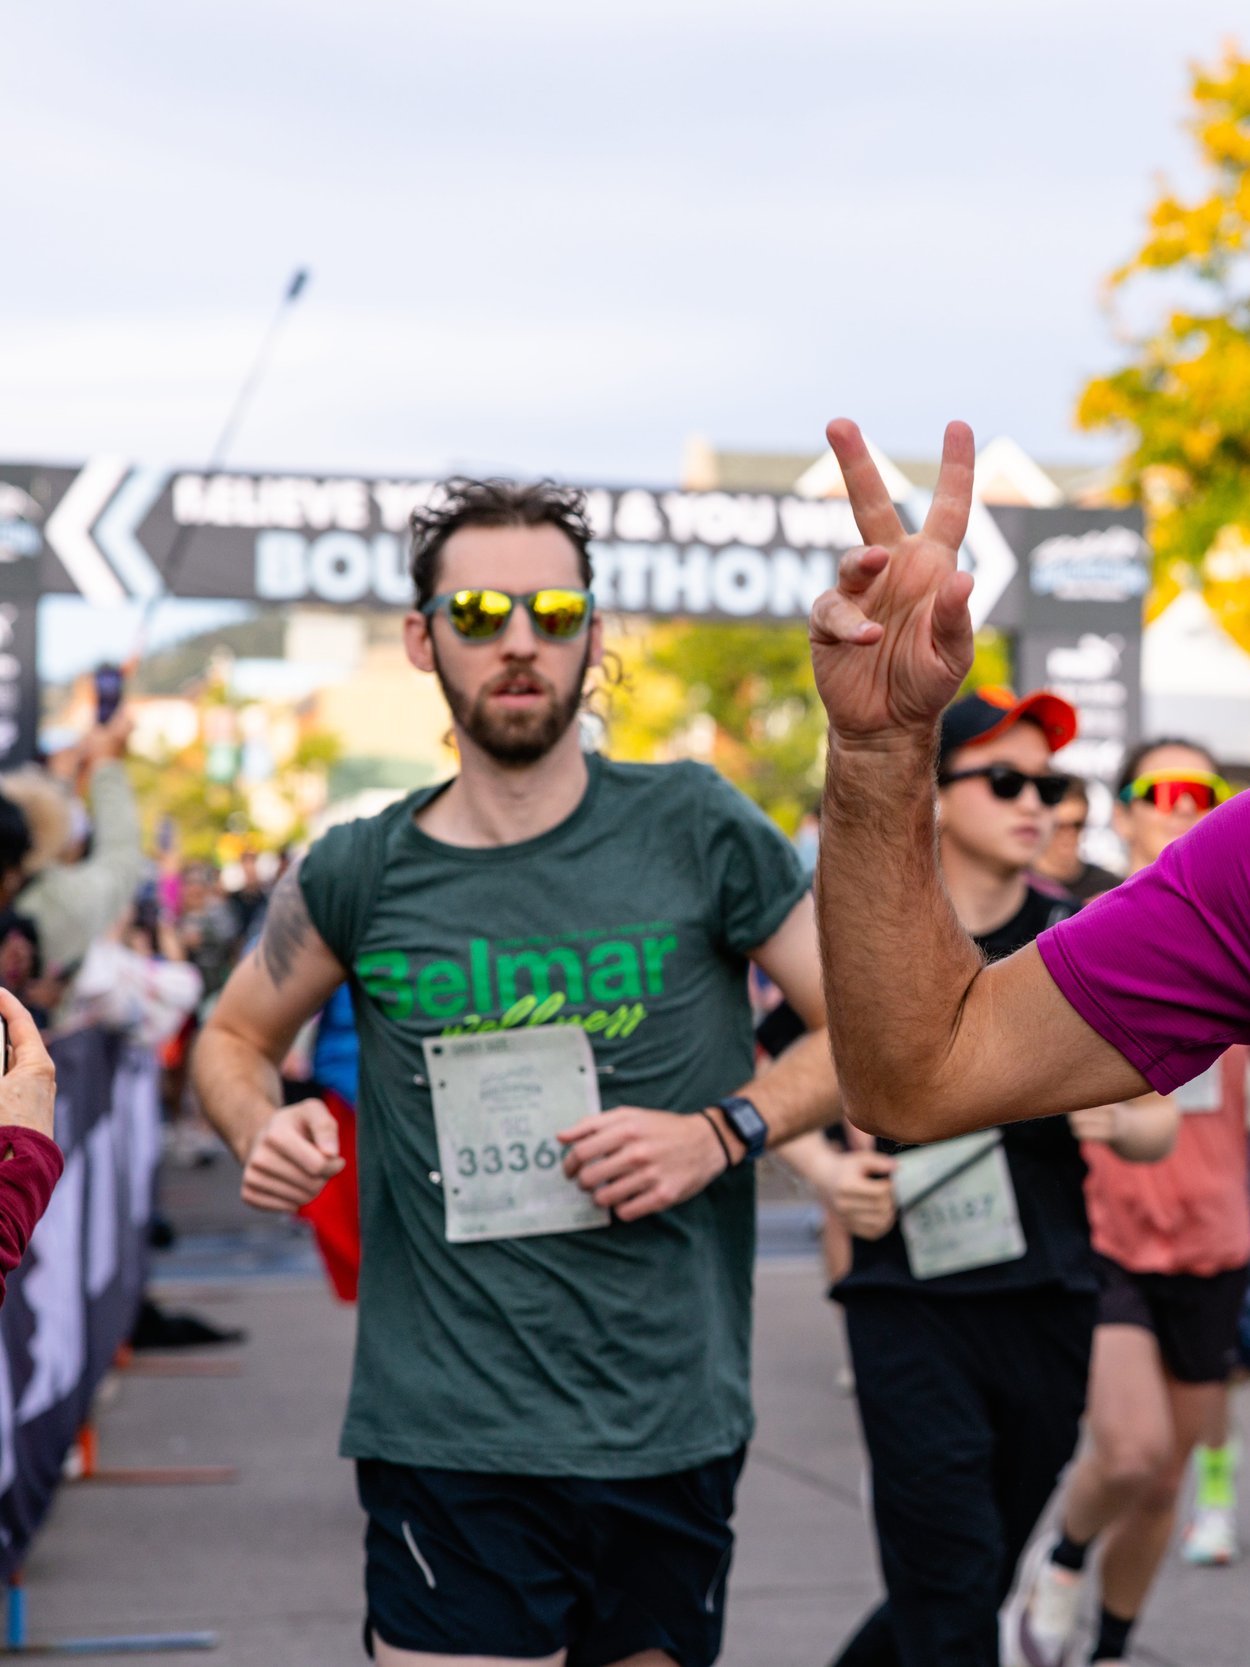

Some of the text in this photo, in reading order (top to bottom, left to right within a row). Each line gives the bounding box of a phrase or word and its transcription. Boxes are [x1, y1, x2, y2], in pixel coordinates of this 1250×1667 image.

[660, 491, 777, 547] YOU
[254, 528, 838, 618] BOUTHON
[457, 1139, 573, 1178] 3336
